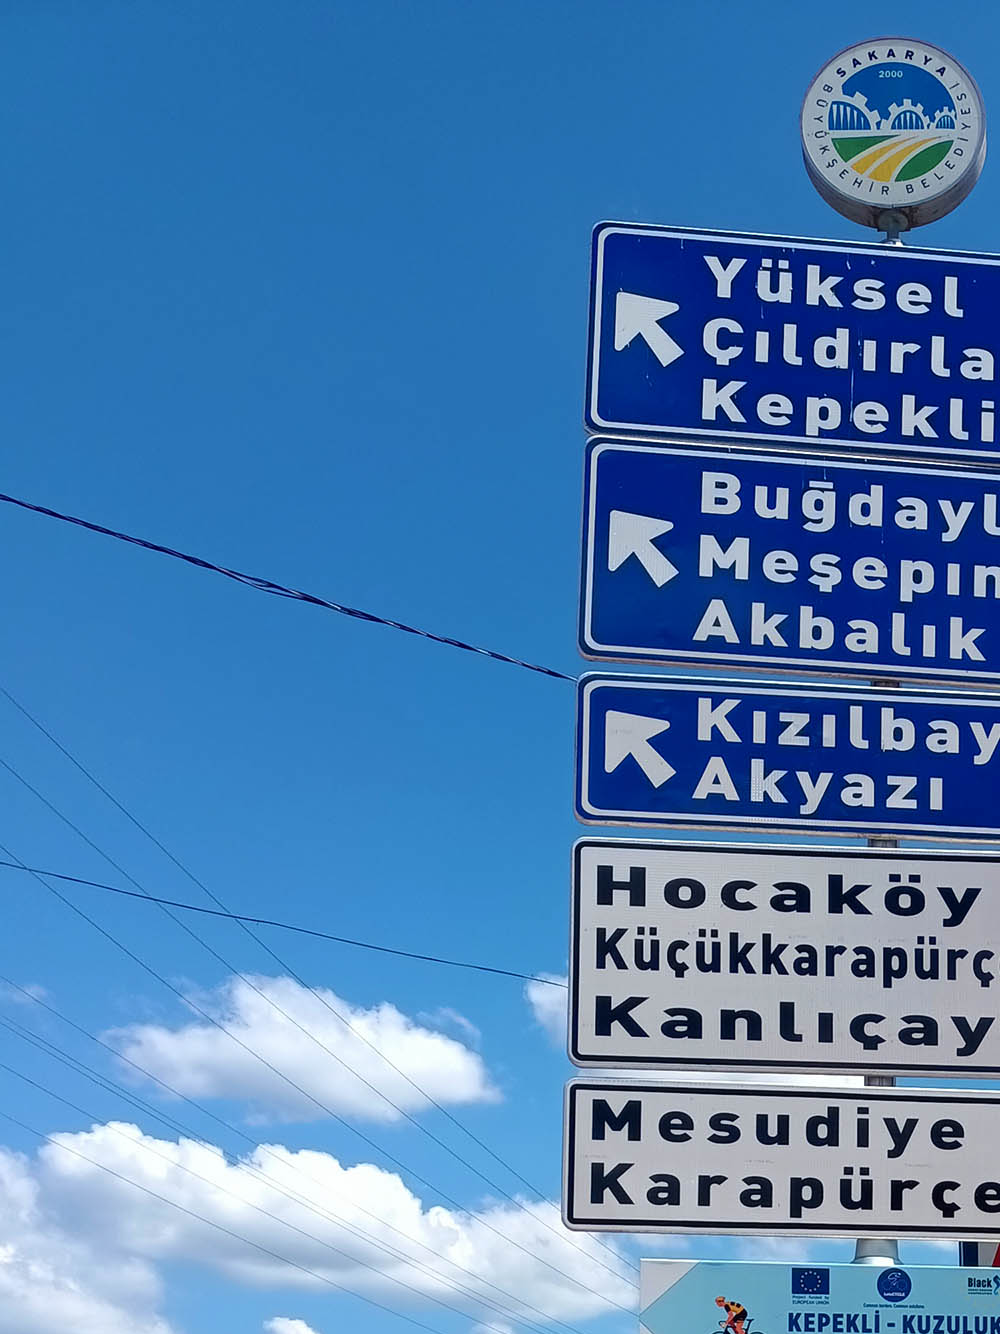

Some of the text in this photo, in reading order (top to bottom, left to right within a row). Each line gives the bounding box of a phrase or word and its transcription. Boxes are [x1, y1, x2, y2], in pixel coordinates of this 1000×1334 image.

[836, 48, 948, 78] SAKARYA
[878, 70, 903, 78] 2000
[703, 255, 964, 318] Yüksel
[701, 378, 995, 443] Kepekli
[692, 599, 988, 662] Akbalık
[692, 756, 944, 815] Akyazı
[596, 864, 982, 927] Hocaköy
[594, 995, 996, 1057] Kanlıçay
[591, 1099, 965, 1158] Mesudiye
[968, 1277, 992, 1288] Black
[787, 1310, 880, 1334] KEPEKLİ
